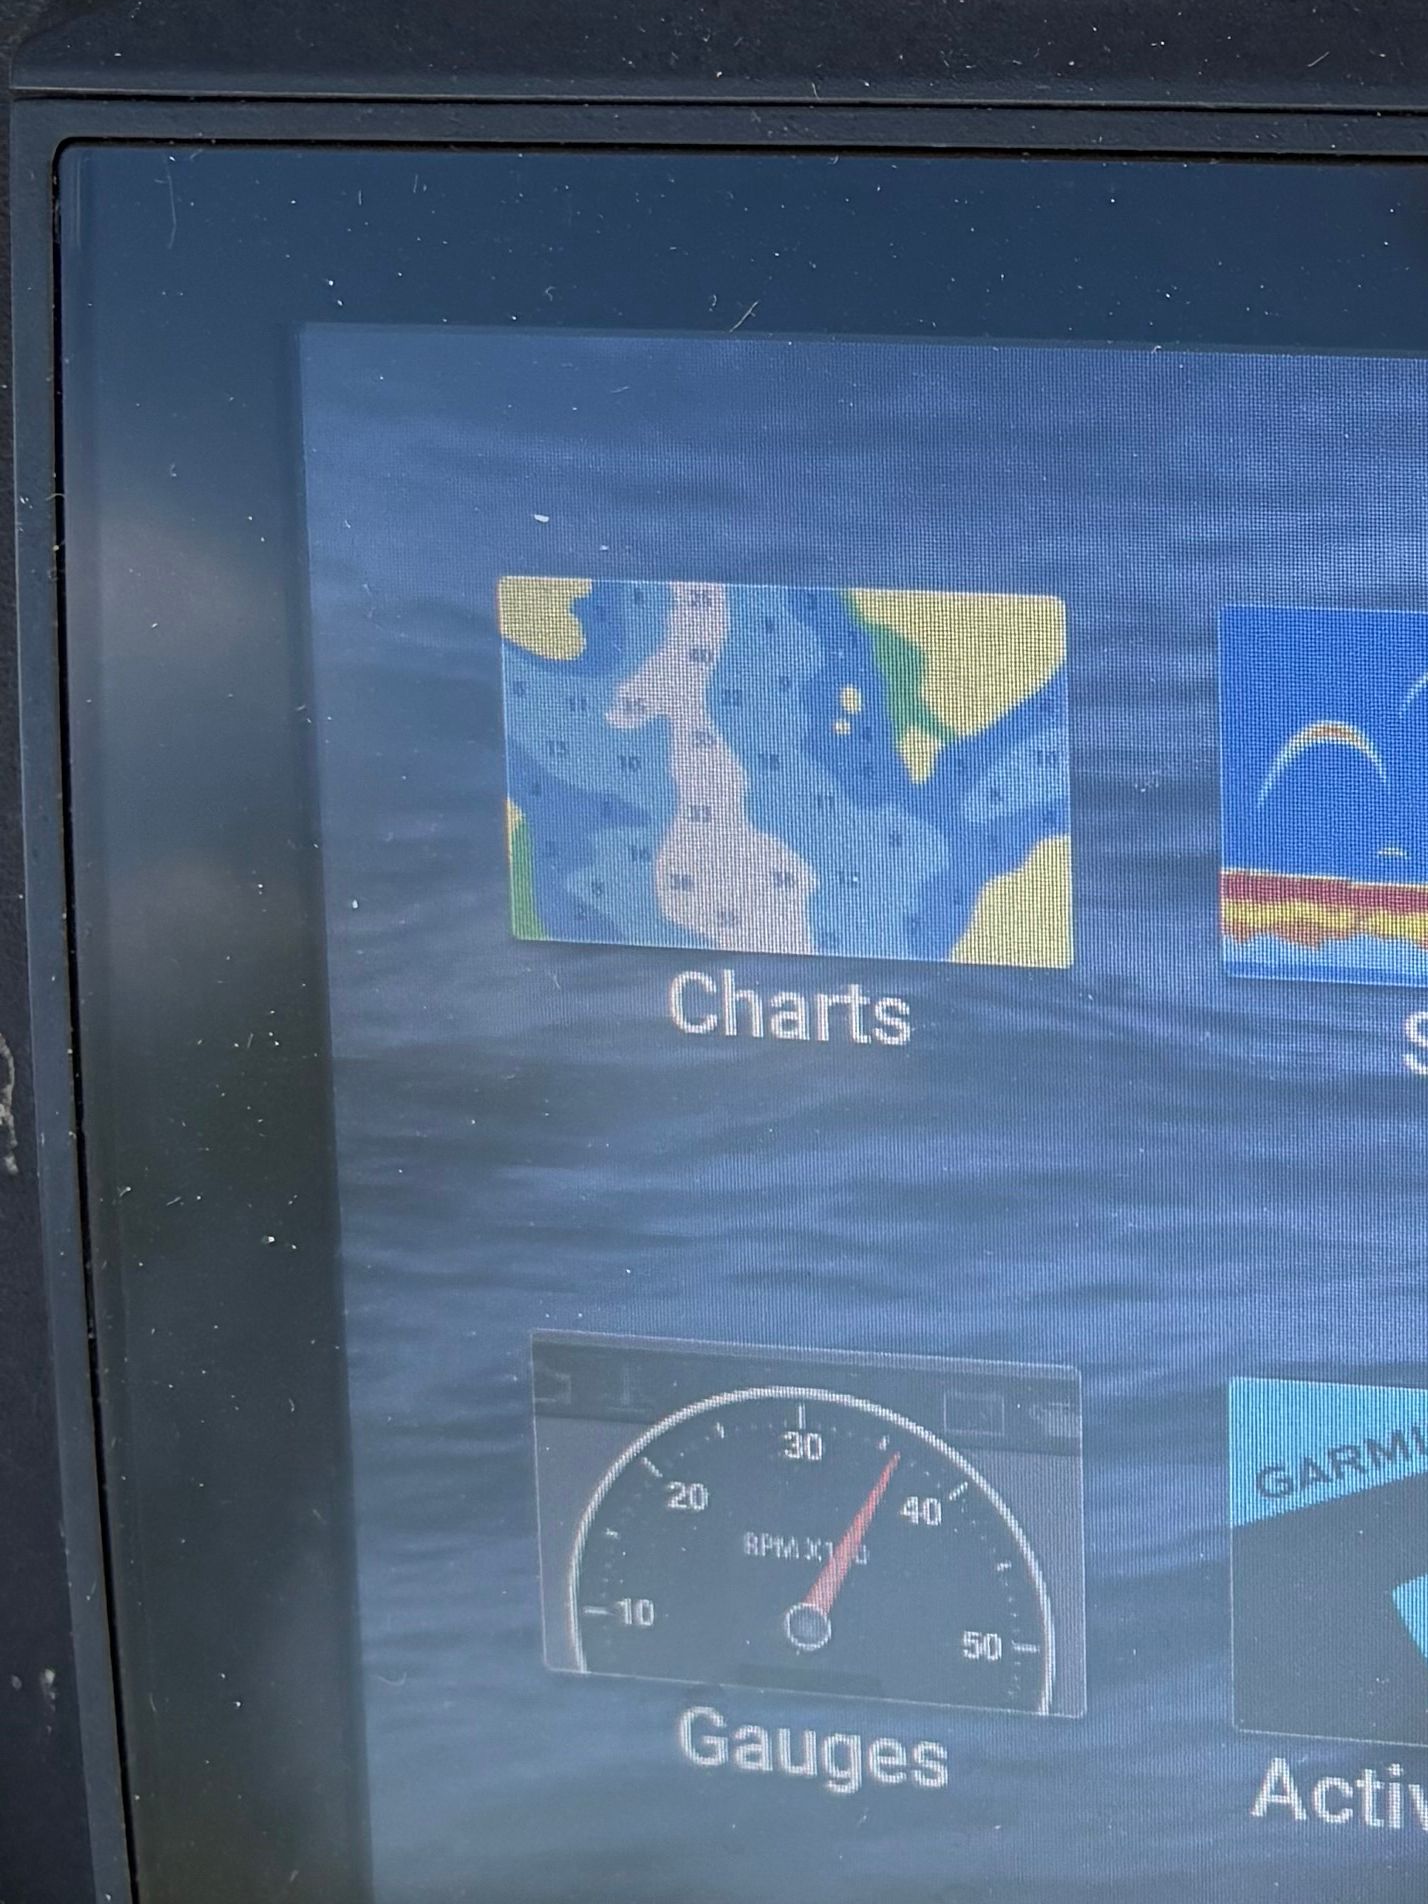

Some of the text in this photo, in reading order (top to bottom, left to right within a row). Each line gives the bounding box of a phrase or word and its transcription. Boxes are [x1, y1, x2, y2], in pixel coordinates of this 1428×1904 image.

[669, 969, 912, 1045] Charts
[783, 1431, 823, 1462] 30
[666, 1481, 709, 1512] 20
[899, 1496, 943, 1526] 40
[618, 1598, 655, 1628] 10
[962, 1630, 1002, 1661] 50
[679, 1705, 949, 1795] Gauges
